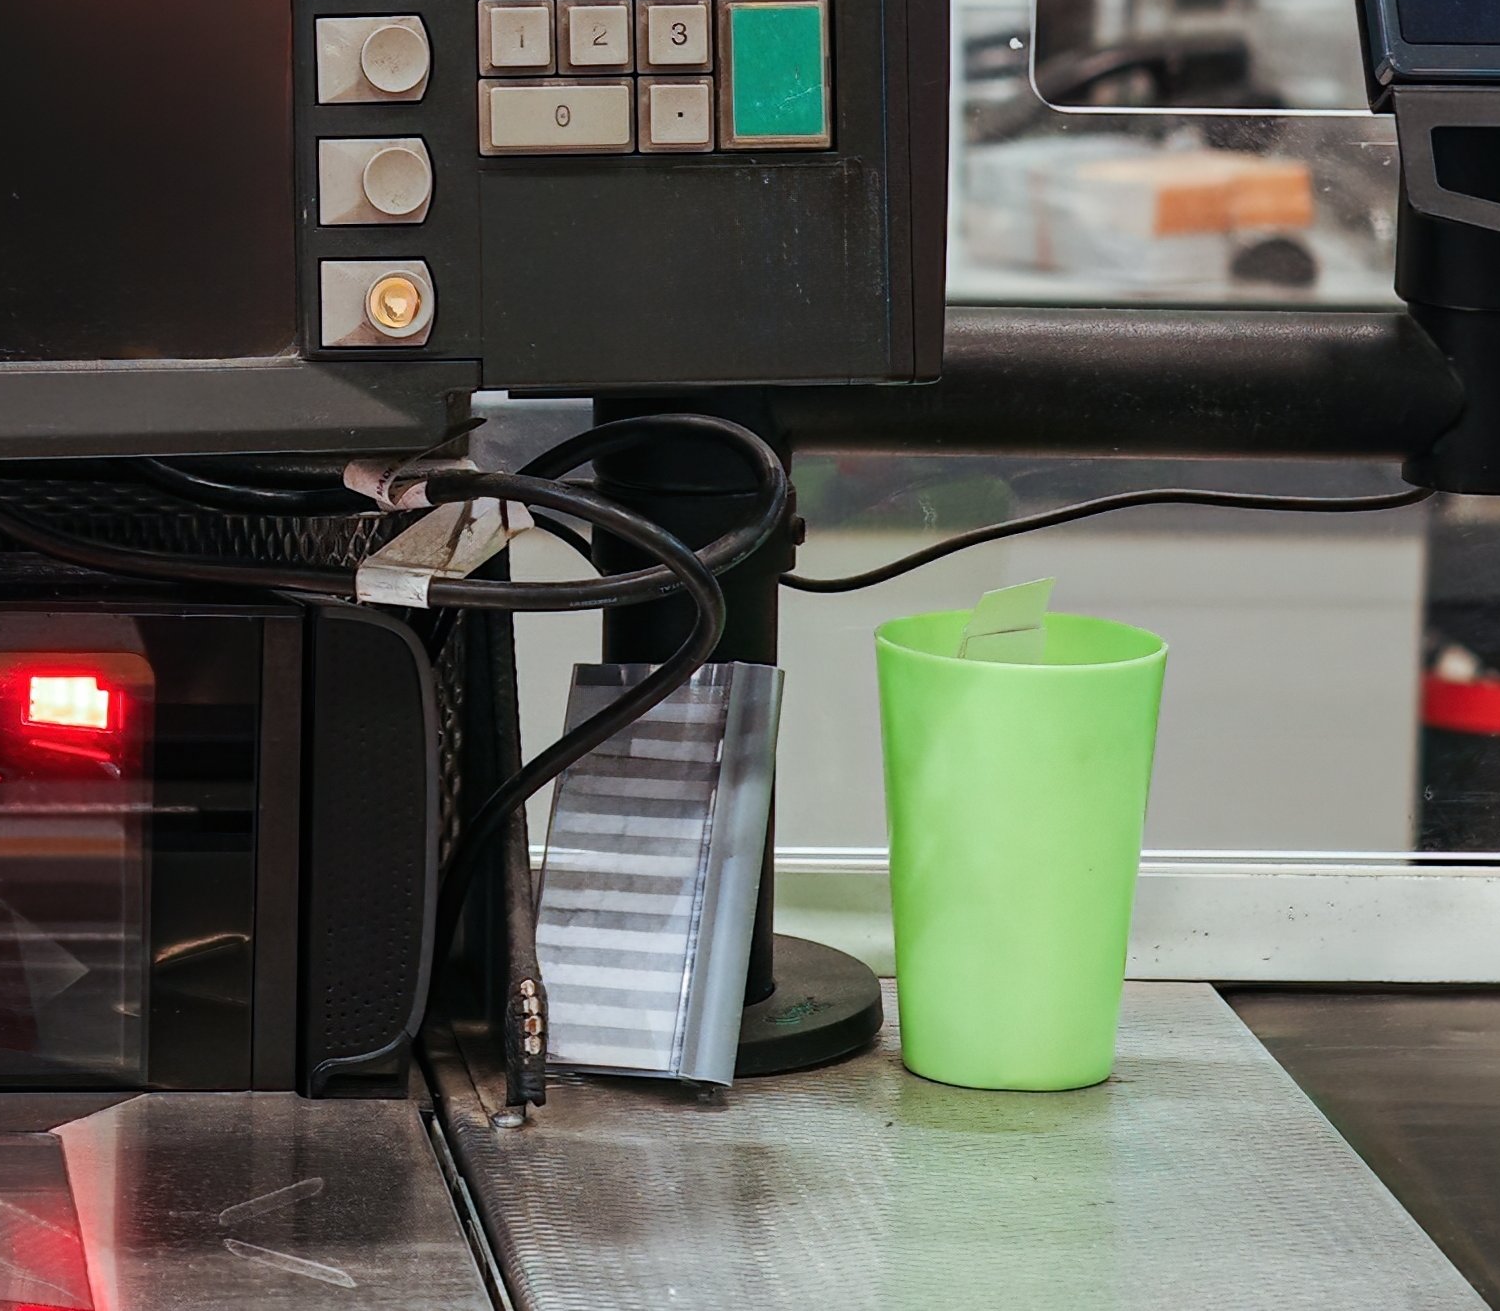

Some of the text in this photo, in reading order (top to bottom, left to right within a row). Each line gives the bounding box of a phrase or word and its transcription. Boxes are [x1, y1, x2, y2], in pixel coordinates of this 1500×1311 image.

[592, 24, 609, 47] 2
[671, 22, 688, 46] 3
[554, 104, 571, 128] 0
